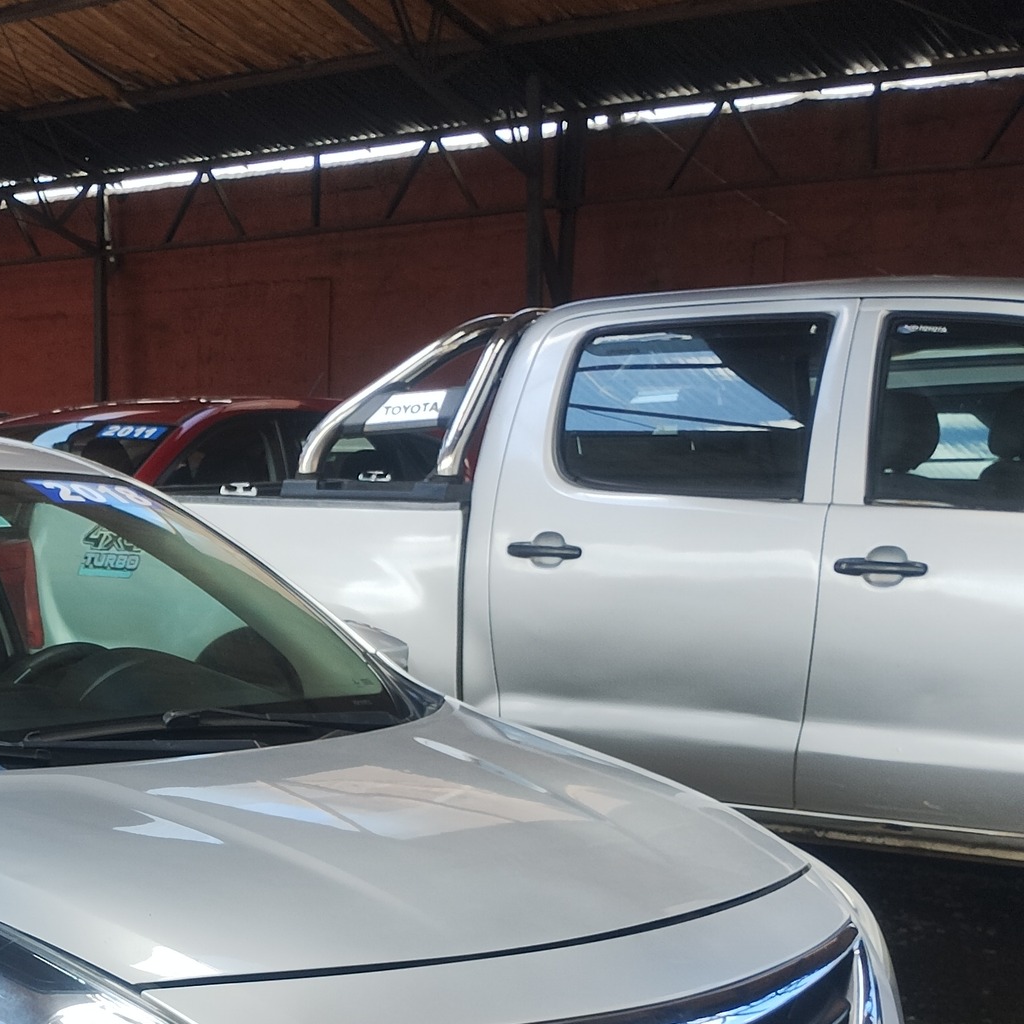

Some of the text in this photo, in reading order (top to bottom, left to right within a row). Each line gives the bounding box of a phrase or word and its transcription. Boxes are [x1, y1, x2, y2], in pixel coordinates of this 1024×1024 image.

[384, 401, 439, 416] TOYOTA
[101, 424, 158, 439] 2011
[42, 480, 153, 507] 2018
[83, 553, 140, 571] TURBO
